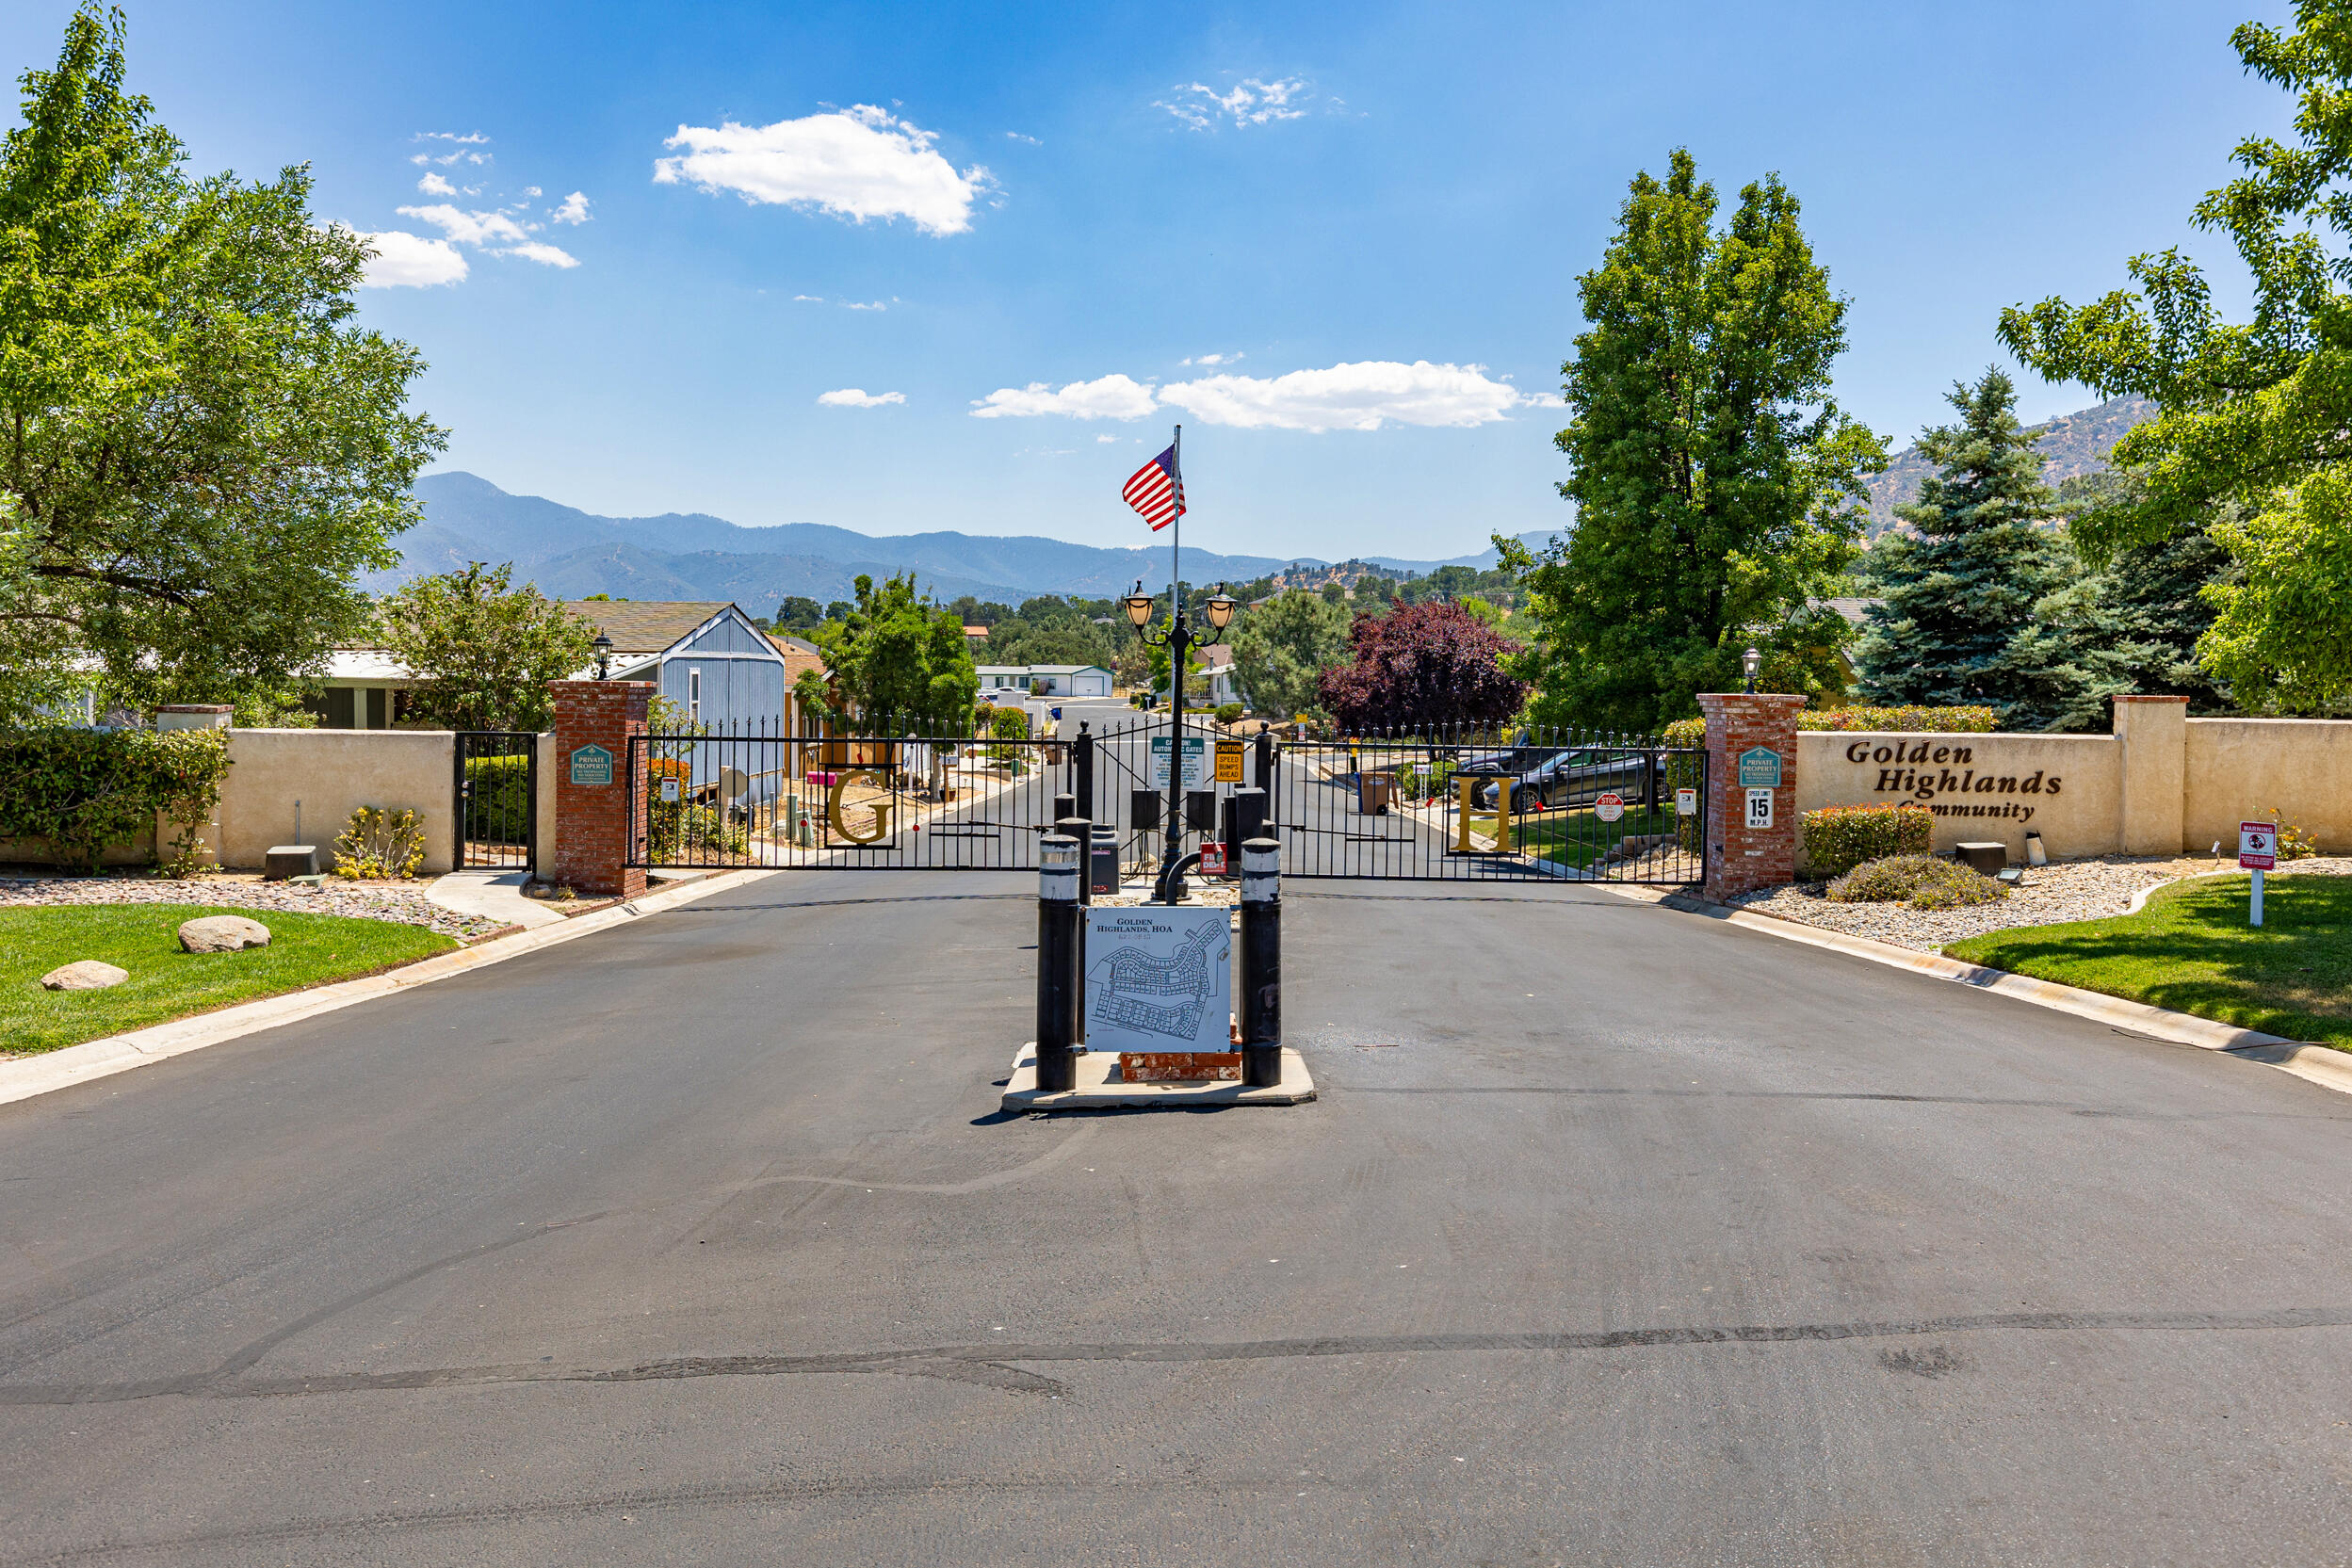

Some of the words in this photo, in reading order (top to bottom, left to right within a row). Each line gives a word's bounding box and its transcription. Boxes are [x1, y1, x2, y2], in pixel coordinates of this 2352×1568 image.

[1846, 739, 1972, 764] Golden
[1873, 768, 2063, 800] Highlands
[829, 769, 894, 844] G
[1451, 777, 1519, 852] H
[1750, 799, 1769, 817] 15
[1899, 800, 2036, 823] mmunity
[2243, 825, 2273, 833] WARNING
